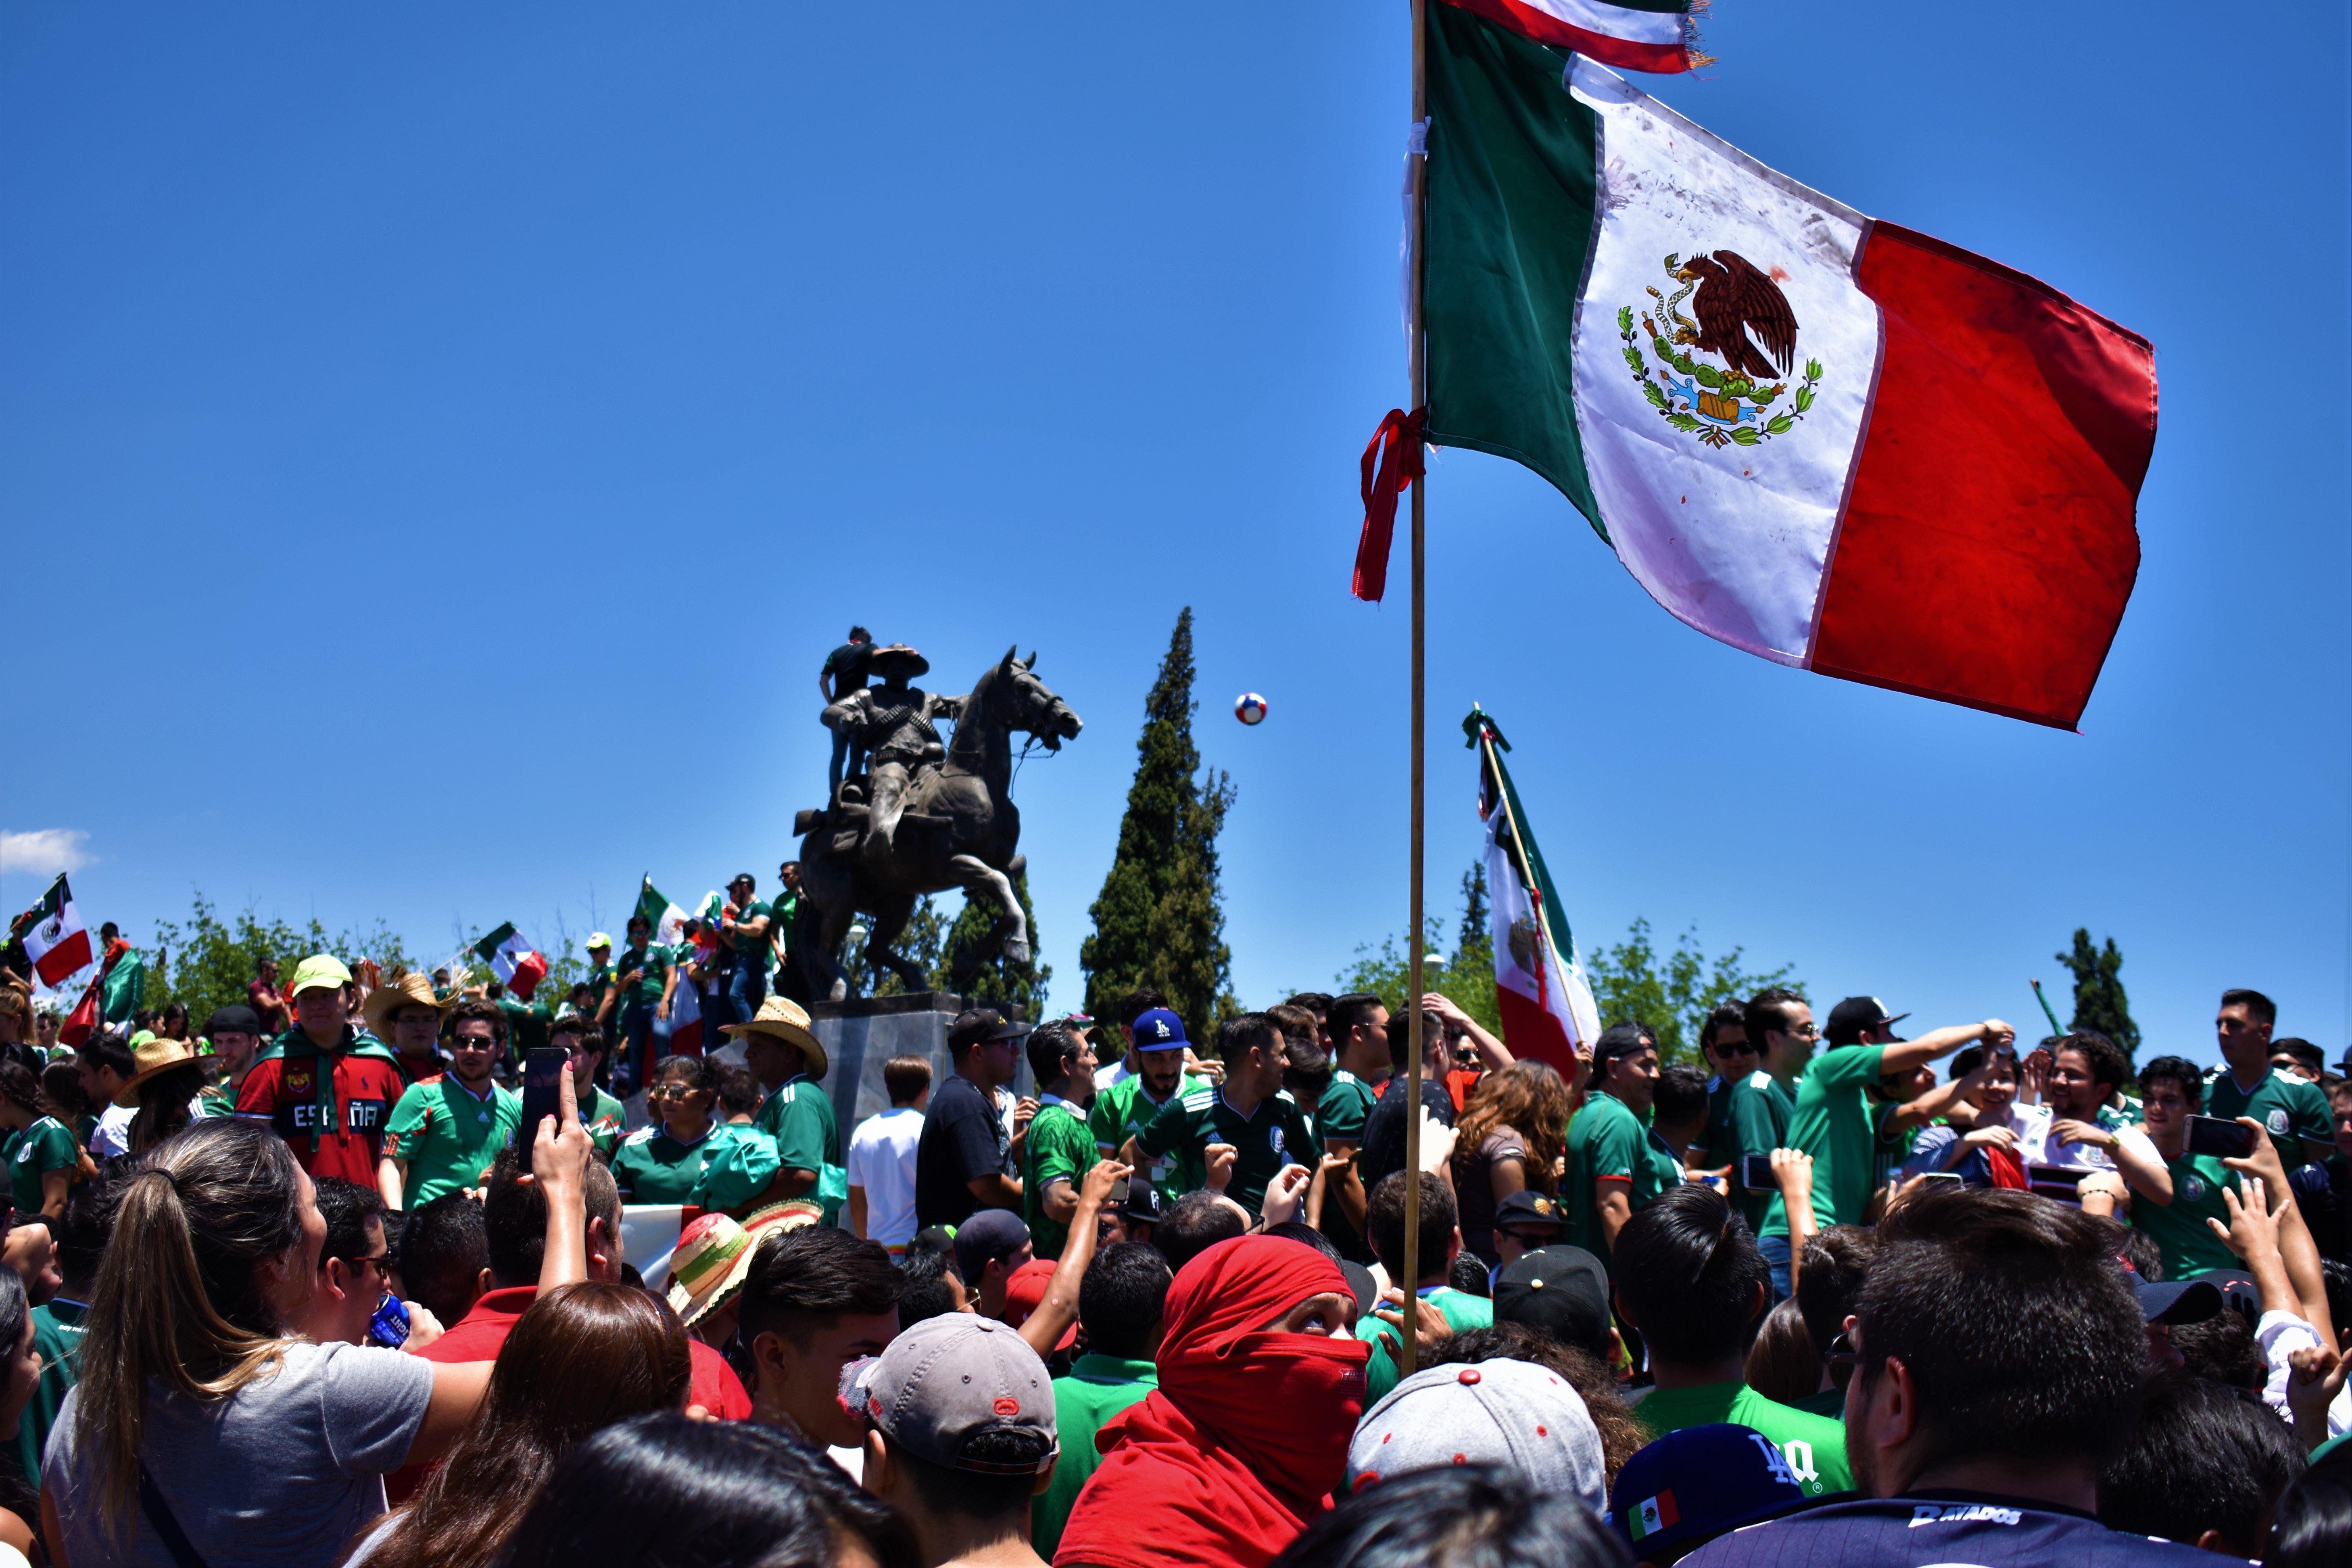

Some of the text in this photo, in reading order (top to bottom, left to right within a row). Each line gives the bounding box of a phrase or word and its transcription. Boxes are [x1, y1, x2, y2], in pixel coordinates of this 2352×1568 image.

[1156, 1019, 1170, 1037] LA
[294, 1101, 377, 1127] ESÑA
[390, 1314, 409, 1336] IGHT
[1748, 1434, 1799, 1487] LA
[1907, 1505, 2023, 1528] RAYADOS
